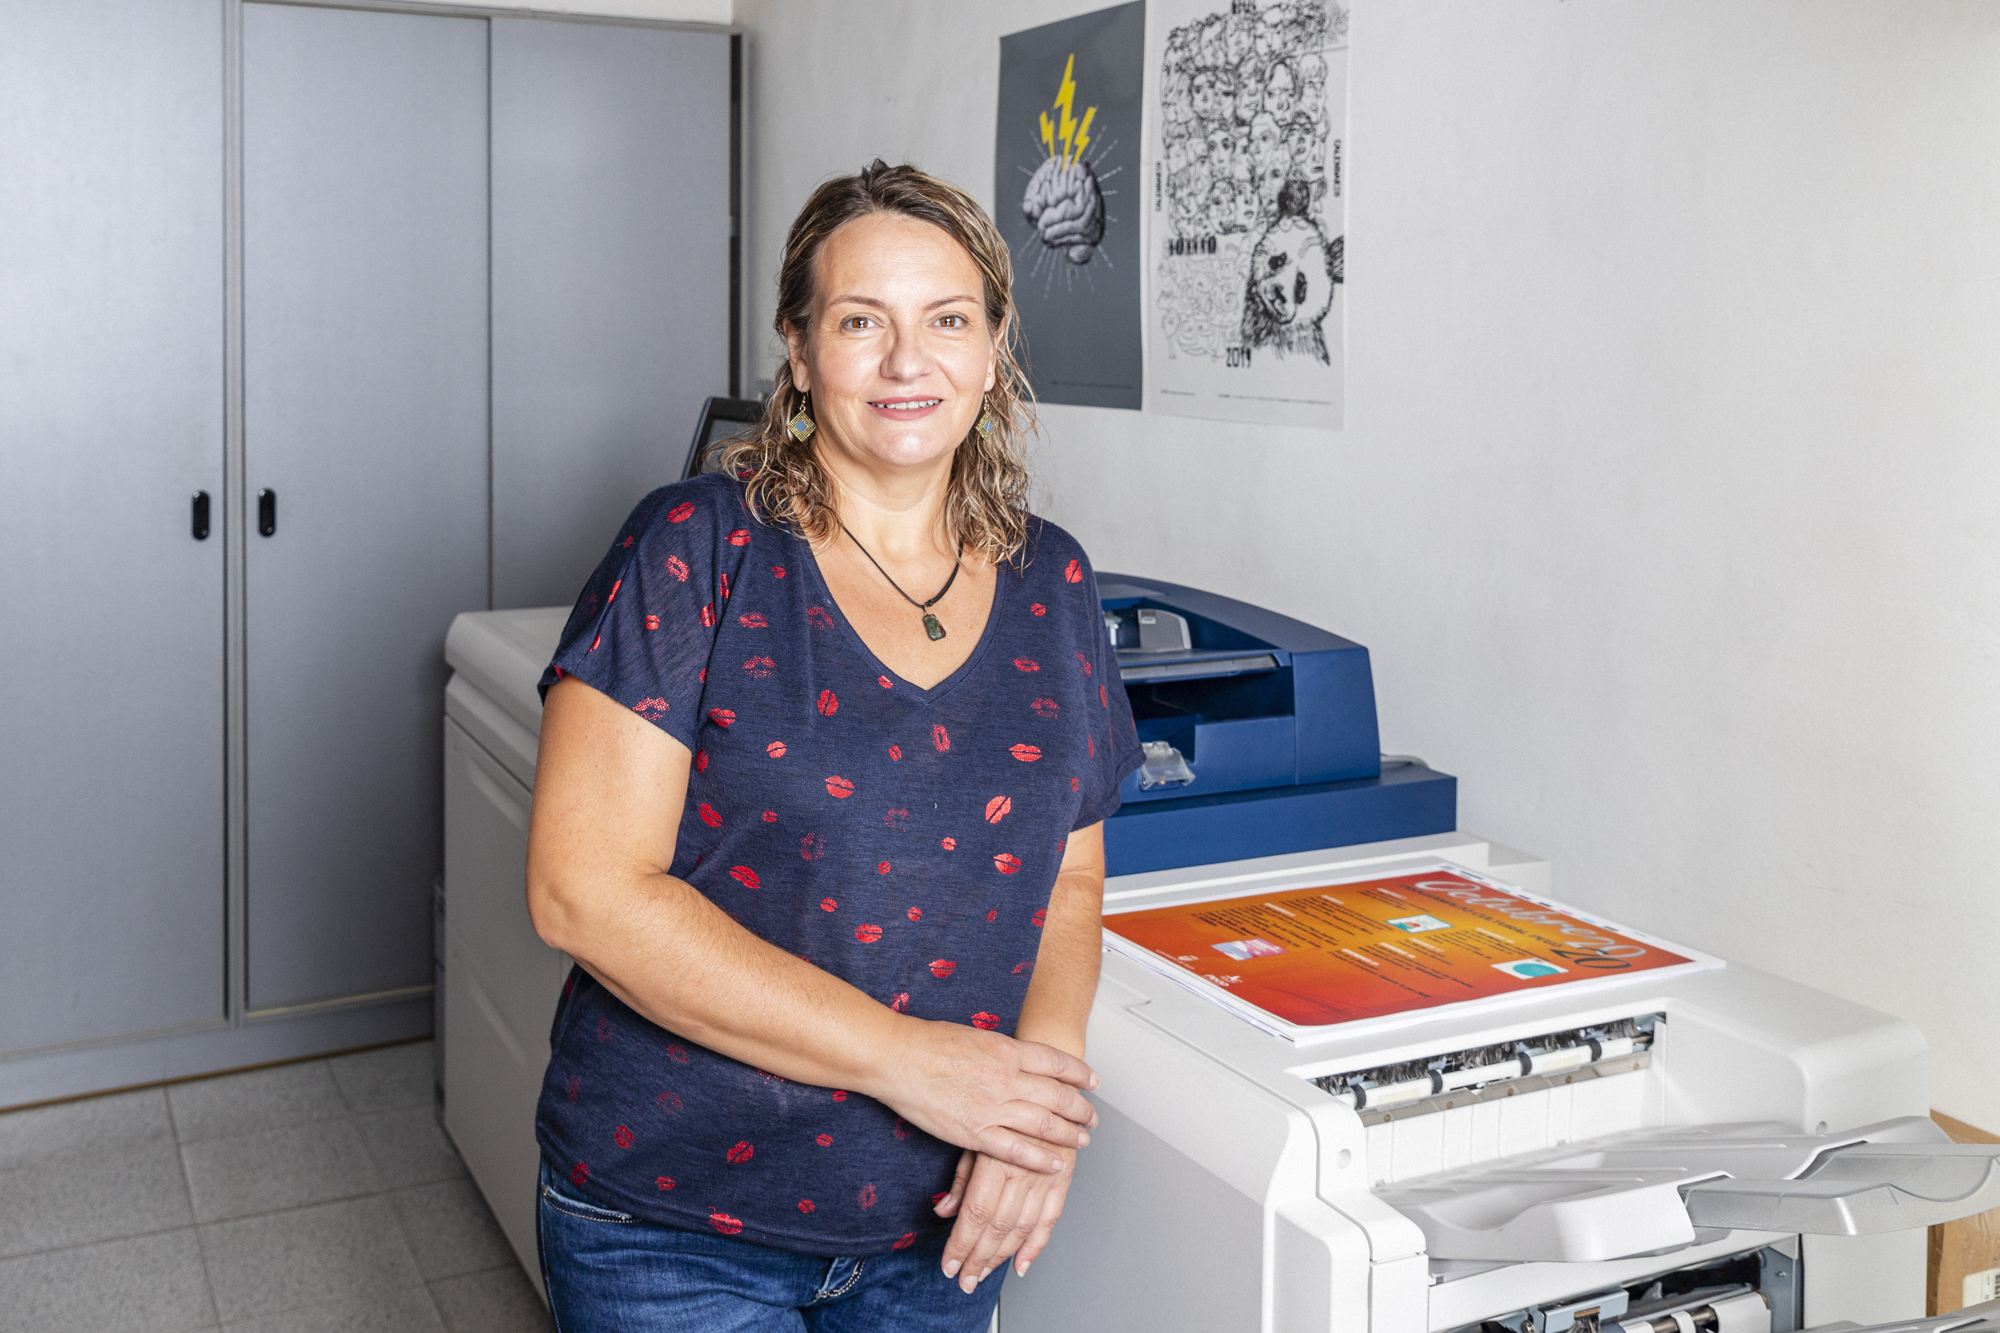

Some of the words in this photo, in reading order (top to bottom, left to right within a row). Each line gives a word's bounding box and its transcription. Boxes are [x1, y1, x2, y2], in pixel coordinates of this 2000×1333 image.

[1226, 347, 1252, 368] 2019
[1472, 911, 1528, 935] CULTURAL
[1549, 946, 1633, 969] 20
